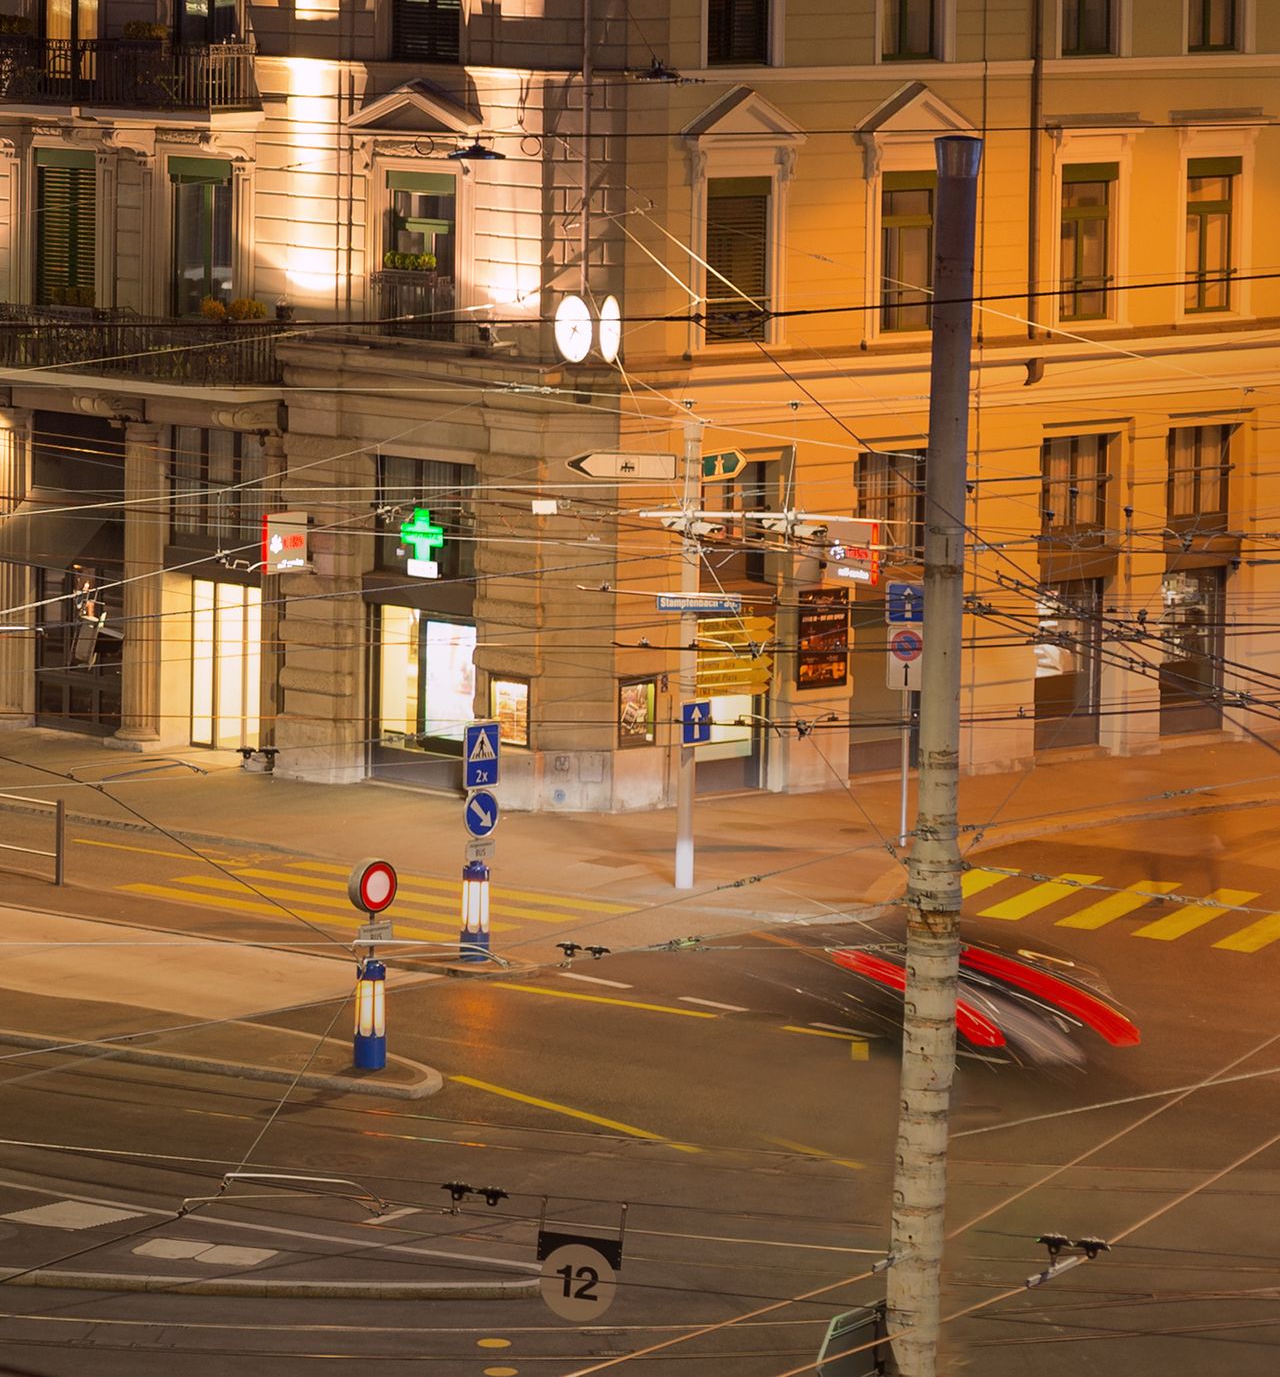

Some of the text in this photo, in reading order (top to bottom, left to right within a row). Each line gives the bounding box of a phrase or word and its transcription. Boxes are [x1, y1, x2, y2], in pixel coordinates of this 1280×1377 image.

[475, 769, 488, 783] 2x
[475, 847, 487, 857] BUS
[556, 1264, 599, 1302] 12
